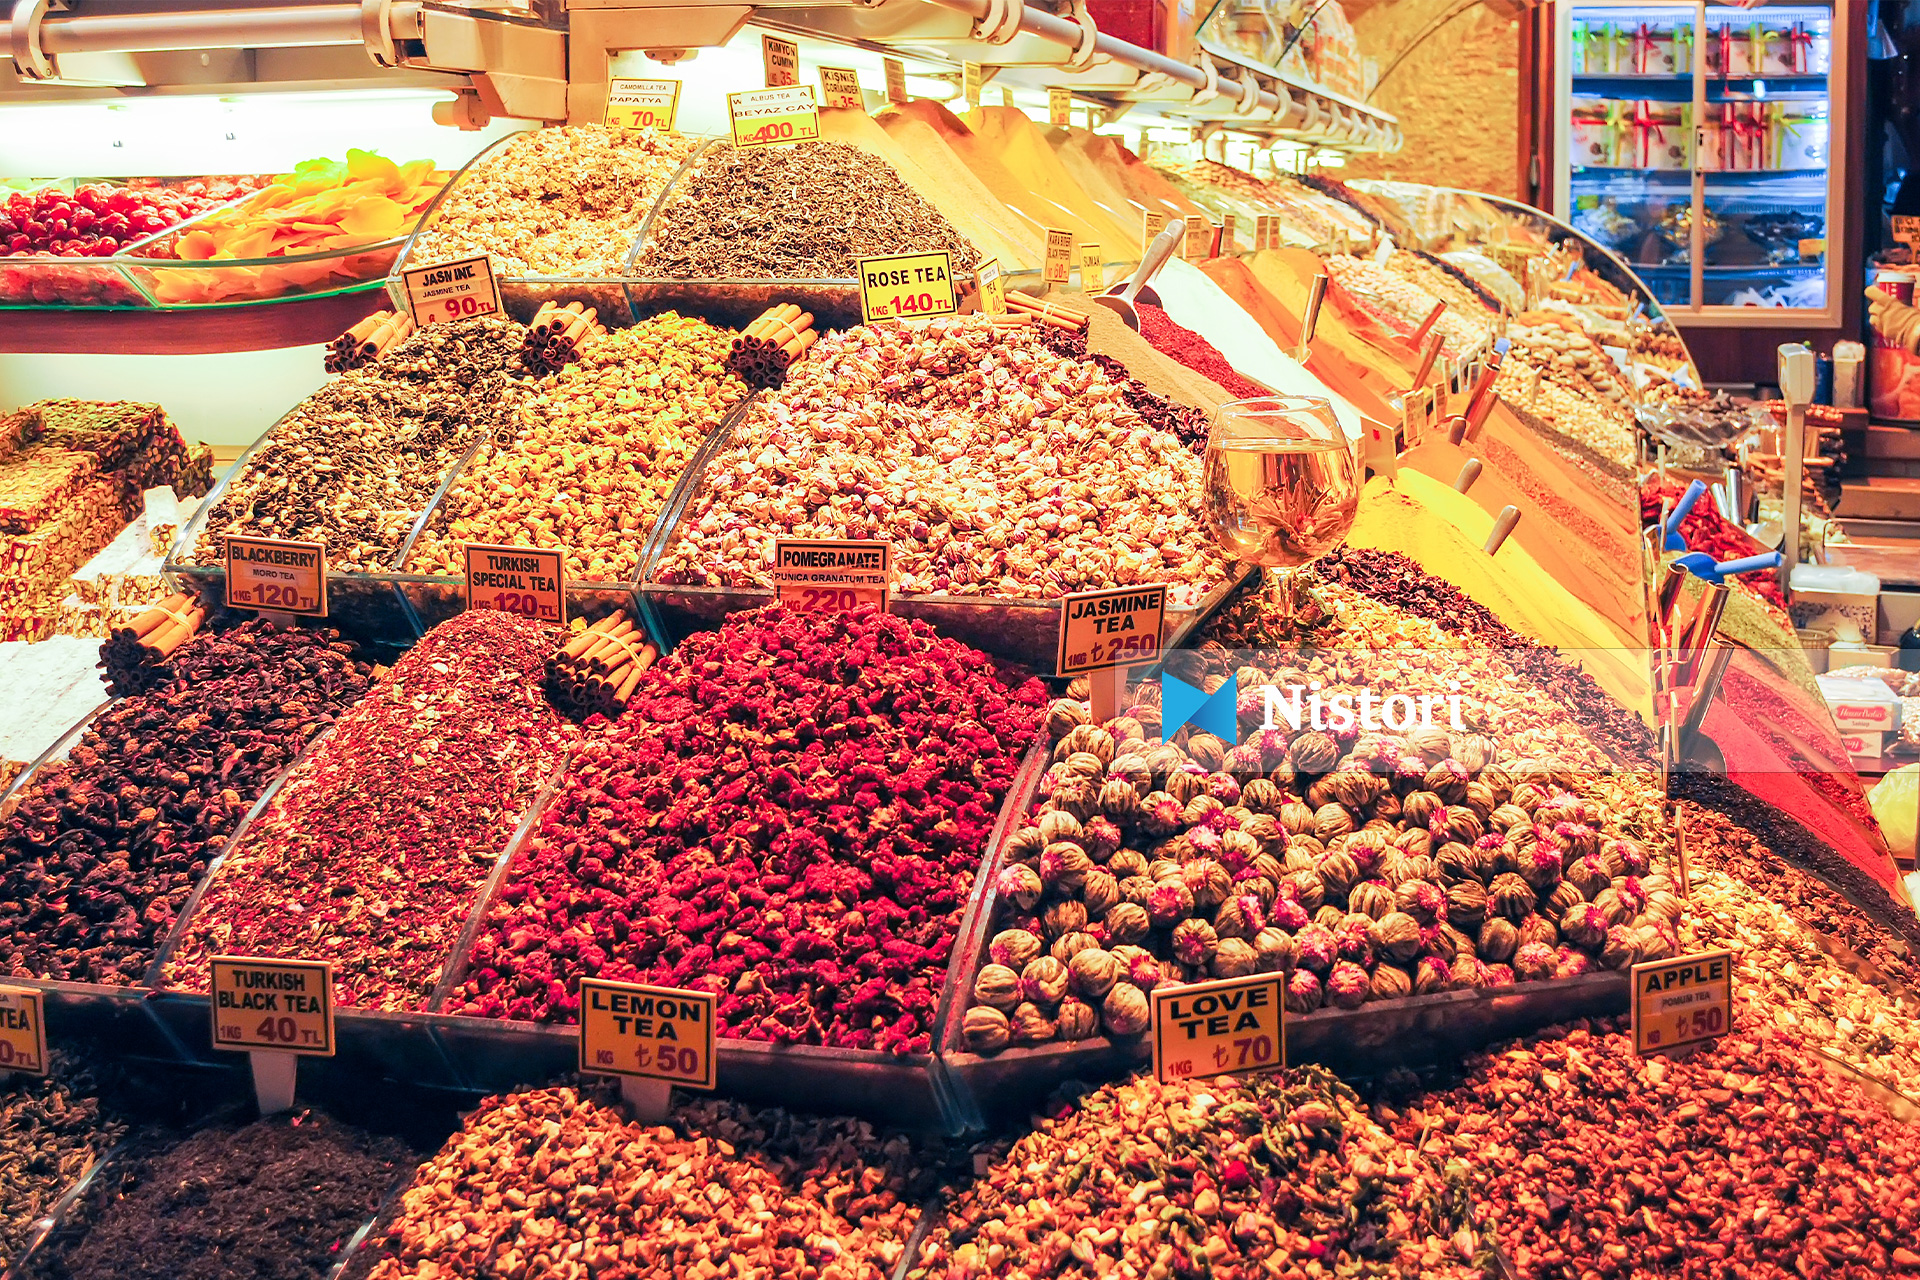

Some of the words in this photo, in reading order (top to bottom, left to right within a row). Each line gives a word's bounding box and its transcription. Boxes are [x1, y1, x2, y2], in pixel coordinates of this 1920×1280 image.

[771, 55, 794, 69] CUMIN
[607, 117, 620, 125] 1KG
[631, 111, 654, 127] 70
[655, 118, 667, 127] TL
[734, 107, 781, 117] BEYAZ
[738, 133, 754, 143] 1KG
[753, 122, 794, 143] 400
[799, 127, 815, 136] TL
[867, 269, 910, 288] ROSE
[914, 266, 947, 283] TEA
[422, 286, 454, 298] JASMINE
[455, 284, 471, 292] TEA
[444, 296, 478, 318] 90
[478, 301, 495, 312] TL
[870, 305, 889, 316] 1KG
[889, 292, 934, 314] 140
[934, 299, 952, 310] TL
[231, 545, 317, 568] BLACKBERRY
[487, 555, 540, 573] TURKISH
[783, 550, 880, 569] POMEGRANATE
[252, 568, 278, 579] MORO
[279, 571, 296, 581] TEA
[472, 571, 526, 590] SPECIAL
[529, 575, 556, 593] TEA
[774, 572, 809, 582] PUNICA
[810, 573, 864, 583] GRANATUM
[867, 575, 886, 584] TEA
[233, 589, 252, 602] 1KG
[252, 583, 299, 607] 120
[300, 596, 318, 608] TL
[494, 592, 538, 616] 120
[538, 604, 557, 617] TL
[801, 589, 857, 613] 220
[1070, 593, 1161, 620] JASMINE
[1093, 614, 1135, 635] TEA
[1067, 652, 1087, 667] 1KG
[232, 969, 306, 991] TURKISH
[1645, 962, 1723, 993] APPLE
[218, 990, 278, 1011] BLACK
[284, 994, 322, 1014] TEA
[592, 991, 700, 1023] LEMON
[1170, 987, 1268, 1020] LOVE
[1695, 991, 1711, 1001] TEA
[220, 1025, 242, 1039] 1KG
[256, 1016, 297, 1043] 40
[301, 1029, 323, 1044] TL
[613, 1015, 678, 1041] TEA
[1178, 1010, 1261, 1040] TEA
[16, 1051, 38, 1067] TL
[1168, 1059, 1193, 1077] 1KG
